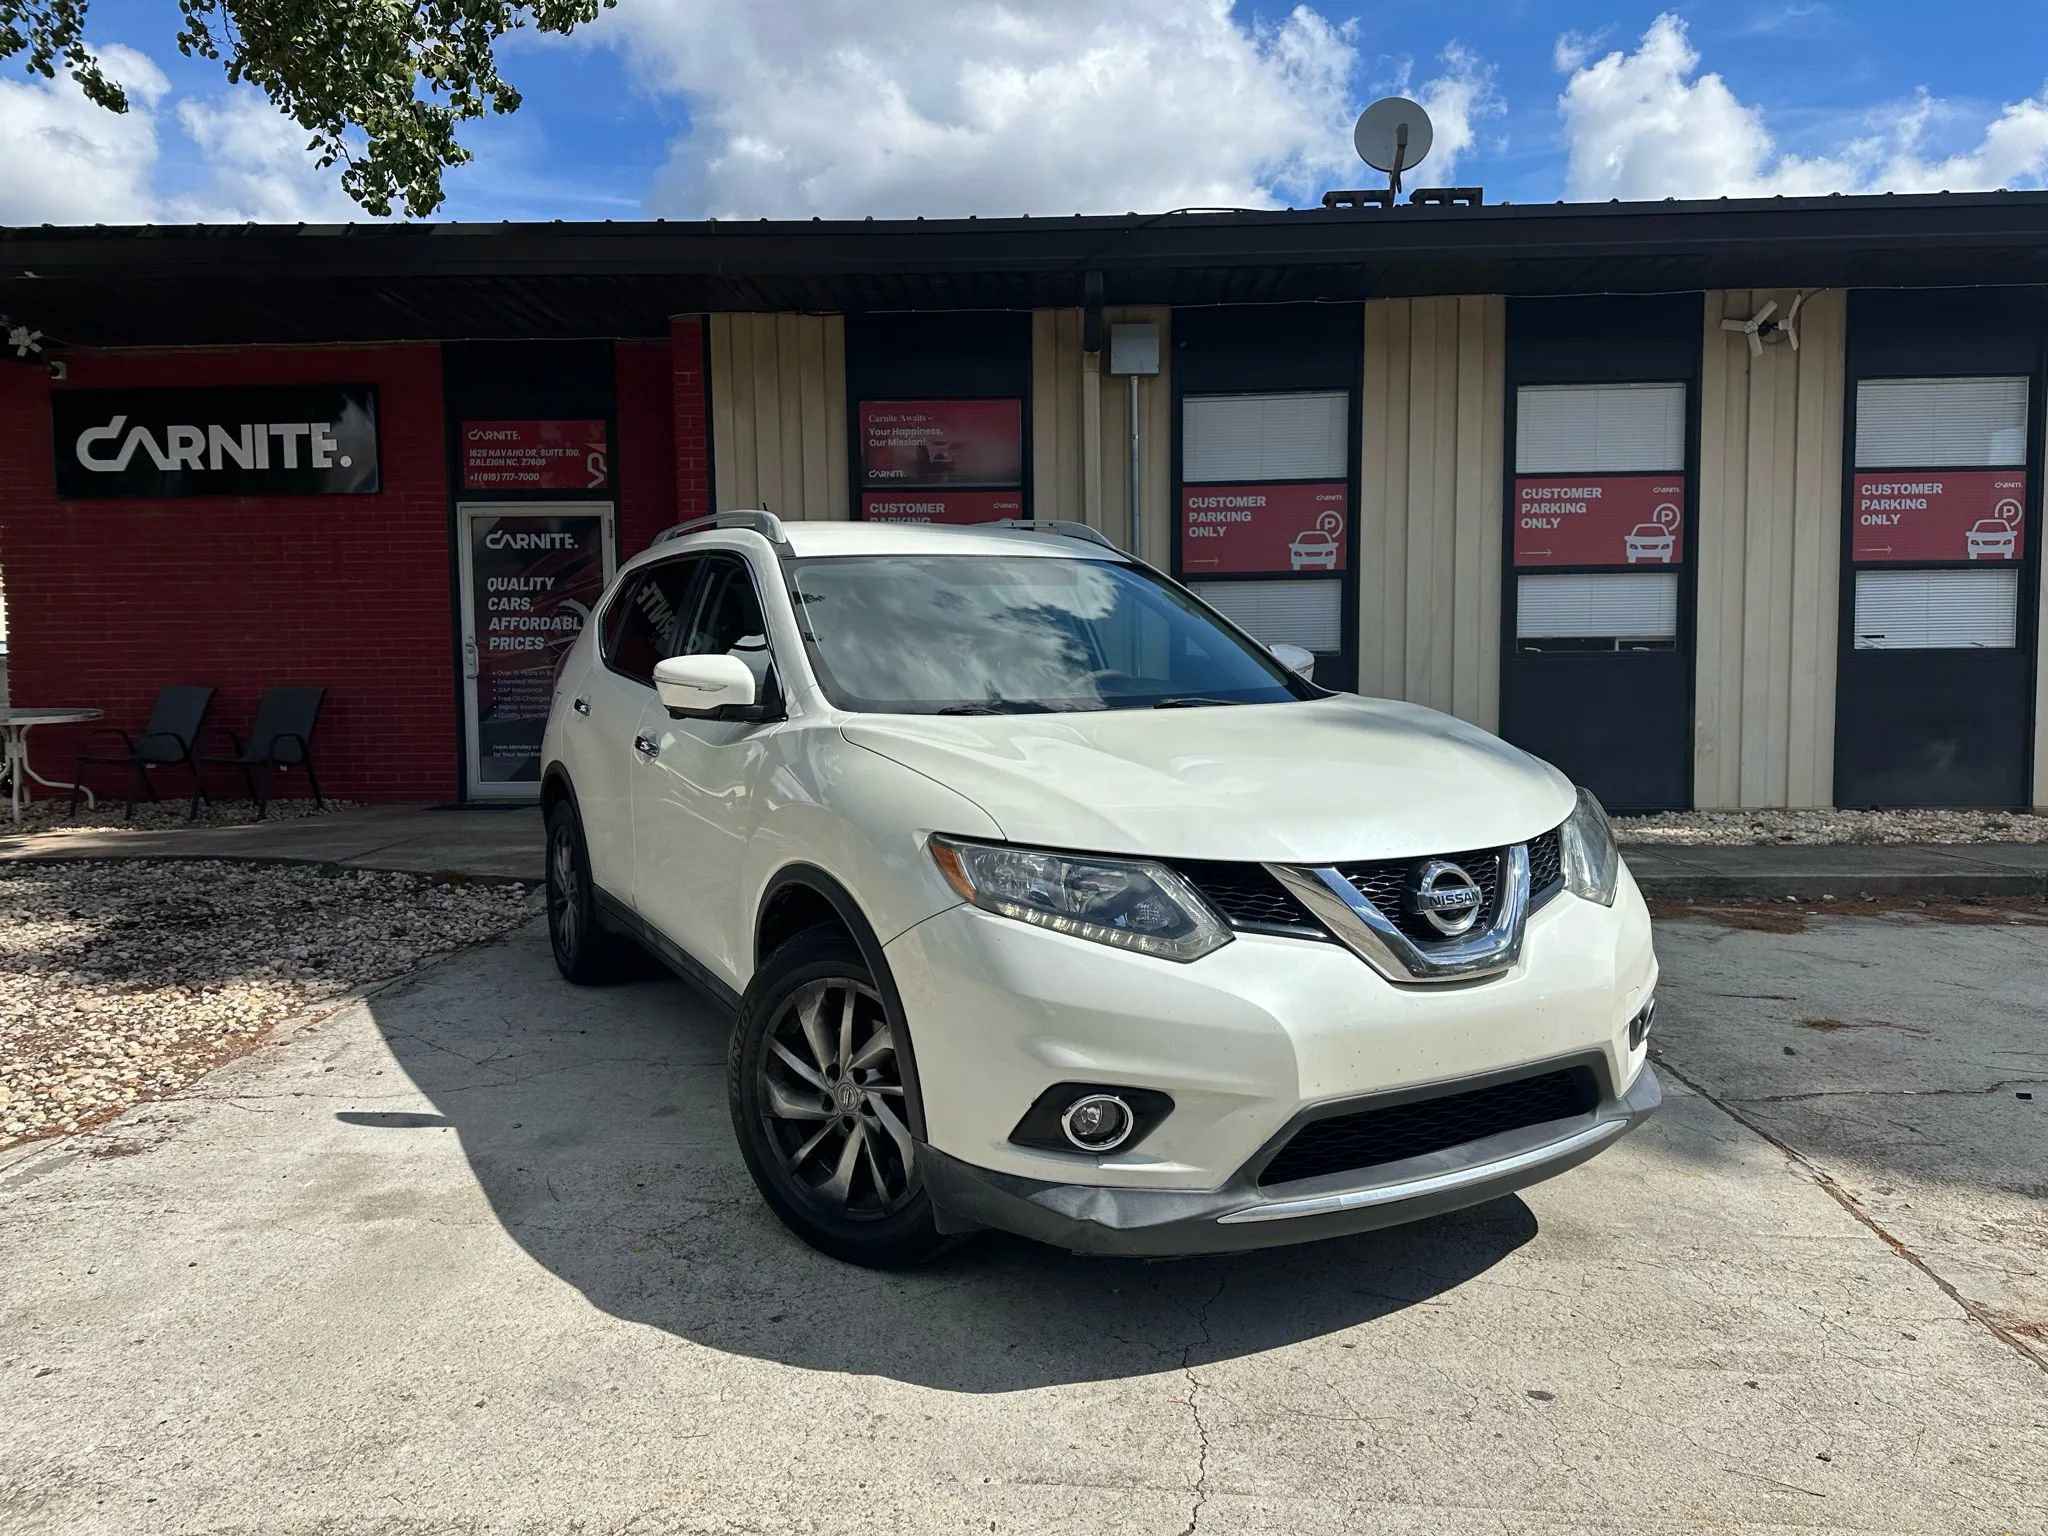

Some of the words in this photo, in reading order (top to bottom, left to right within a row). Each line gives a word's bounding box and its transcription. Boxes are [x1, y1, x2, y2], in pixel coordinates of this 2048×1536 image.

[868, 414, 897, 423] Carnite
[900, 414, 926, 423] Awaits
[869, 428, 890, 437] Your
[869, 438, 887, 447] Our
[888, 437, 927, 447] Mission!
[489, 449, 524, 457] NAVAHO
[540, 449, 563, 457] SUITE
[469, 458, 505, 466] RALEIGH
[1521, 487, 1603, 499] CUSTOMER
[1861, 483, 1943, 496] CUSTOMER
[1188, 496, 1267, 508] CUSTOMER
[1521, 502, 1587, 514] PARKING
[1861, 498, 1928, 511] PARKING
[869, 503, 945, 514] CUSTOMER
[1188, 511, 1252, 523] PARKING
[1521, 517, 1561, 529] ONLY
[1860, 514, 1901, 525] ONLY
[1188, 526, 1228, 538] ONLY
[487, 577, 555, 592] QUALITY
[487, 597, 535, 613] CARS,
[489, 636, 545, 651] PRICES
[498, 712, 520, 720] Quality
[1428, 891, 1480, 906] NISSAN
